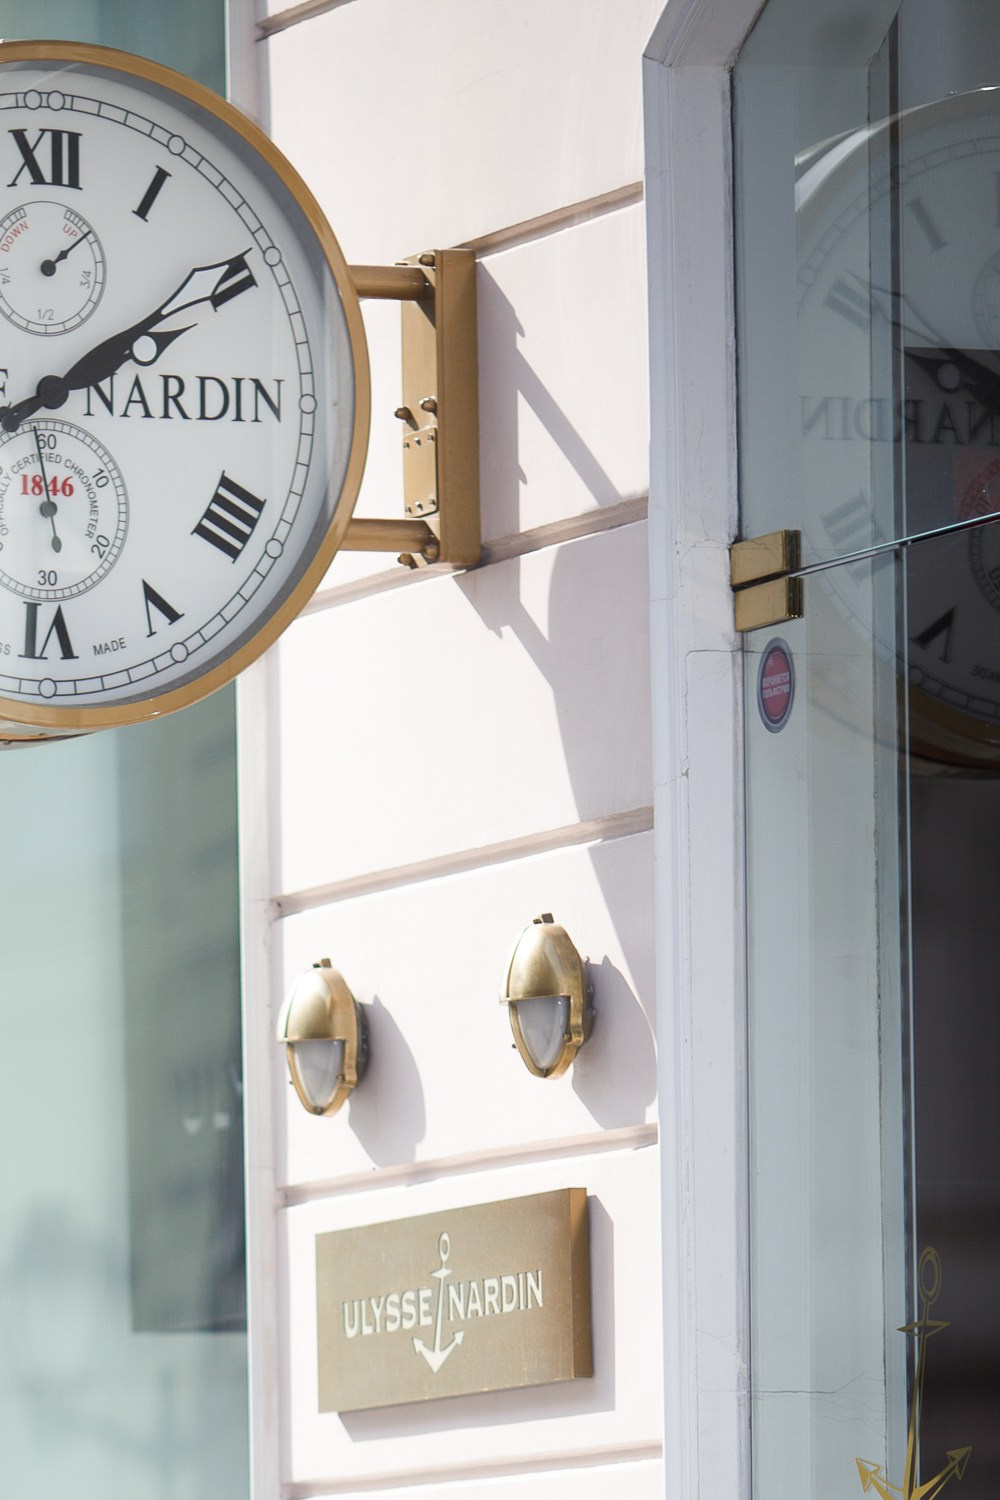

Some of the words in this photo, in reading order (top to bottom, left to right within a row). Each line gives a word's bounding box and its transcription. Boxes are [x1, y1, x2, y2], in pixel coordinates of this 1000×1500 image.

[6, 127, 84, 191] XII
[131, 165, 172, 223] I
[0, 221, 30, 253] DOWN
[62, 223, 79, 239] UP
[80, 269, 93, 290] 3/4
[37, 308, 55, 321] 1/2
[83, 372, 285, 423] NARDIN
[36, 433, 58, 451] 60
[20, 474, 75, 497] 1846
[92, 467, 110, 489] 10
[11, 452, 63, 475] CERTIFIED
[64, 458, 99, 540] CHRONOMETER
[90, 534, 111, 560] 20
[37, 570, 58, 587] 30
[141, 578, 185, 639] V
[17, 601, 80, 660] VI
[93, 637, 127, 656] MADE
[342, 1286, 433, 1339] ULYSSE
[448, 1268, 544, 1323] NARDIN
